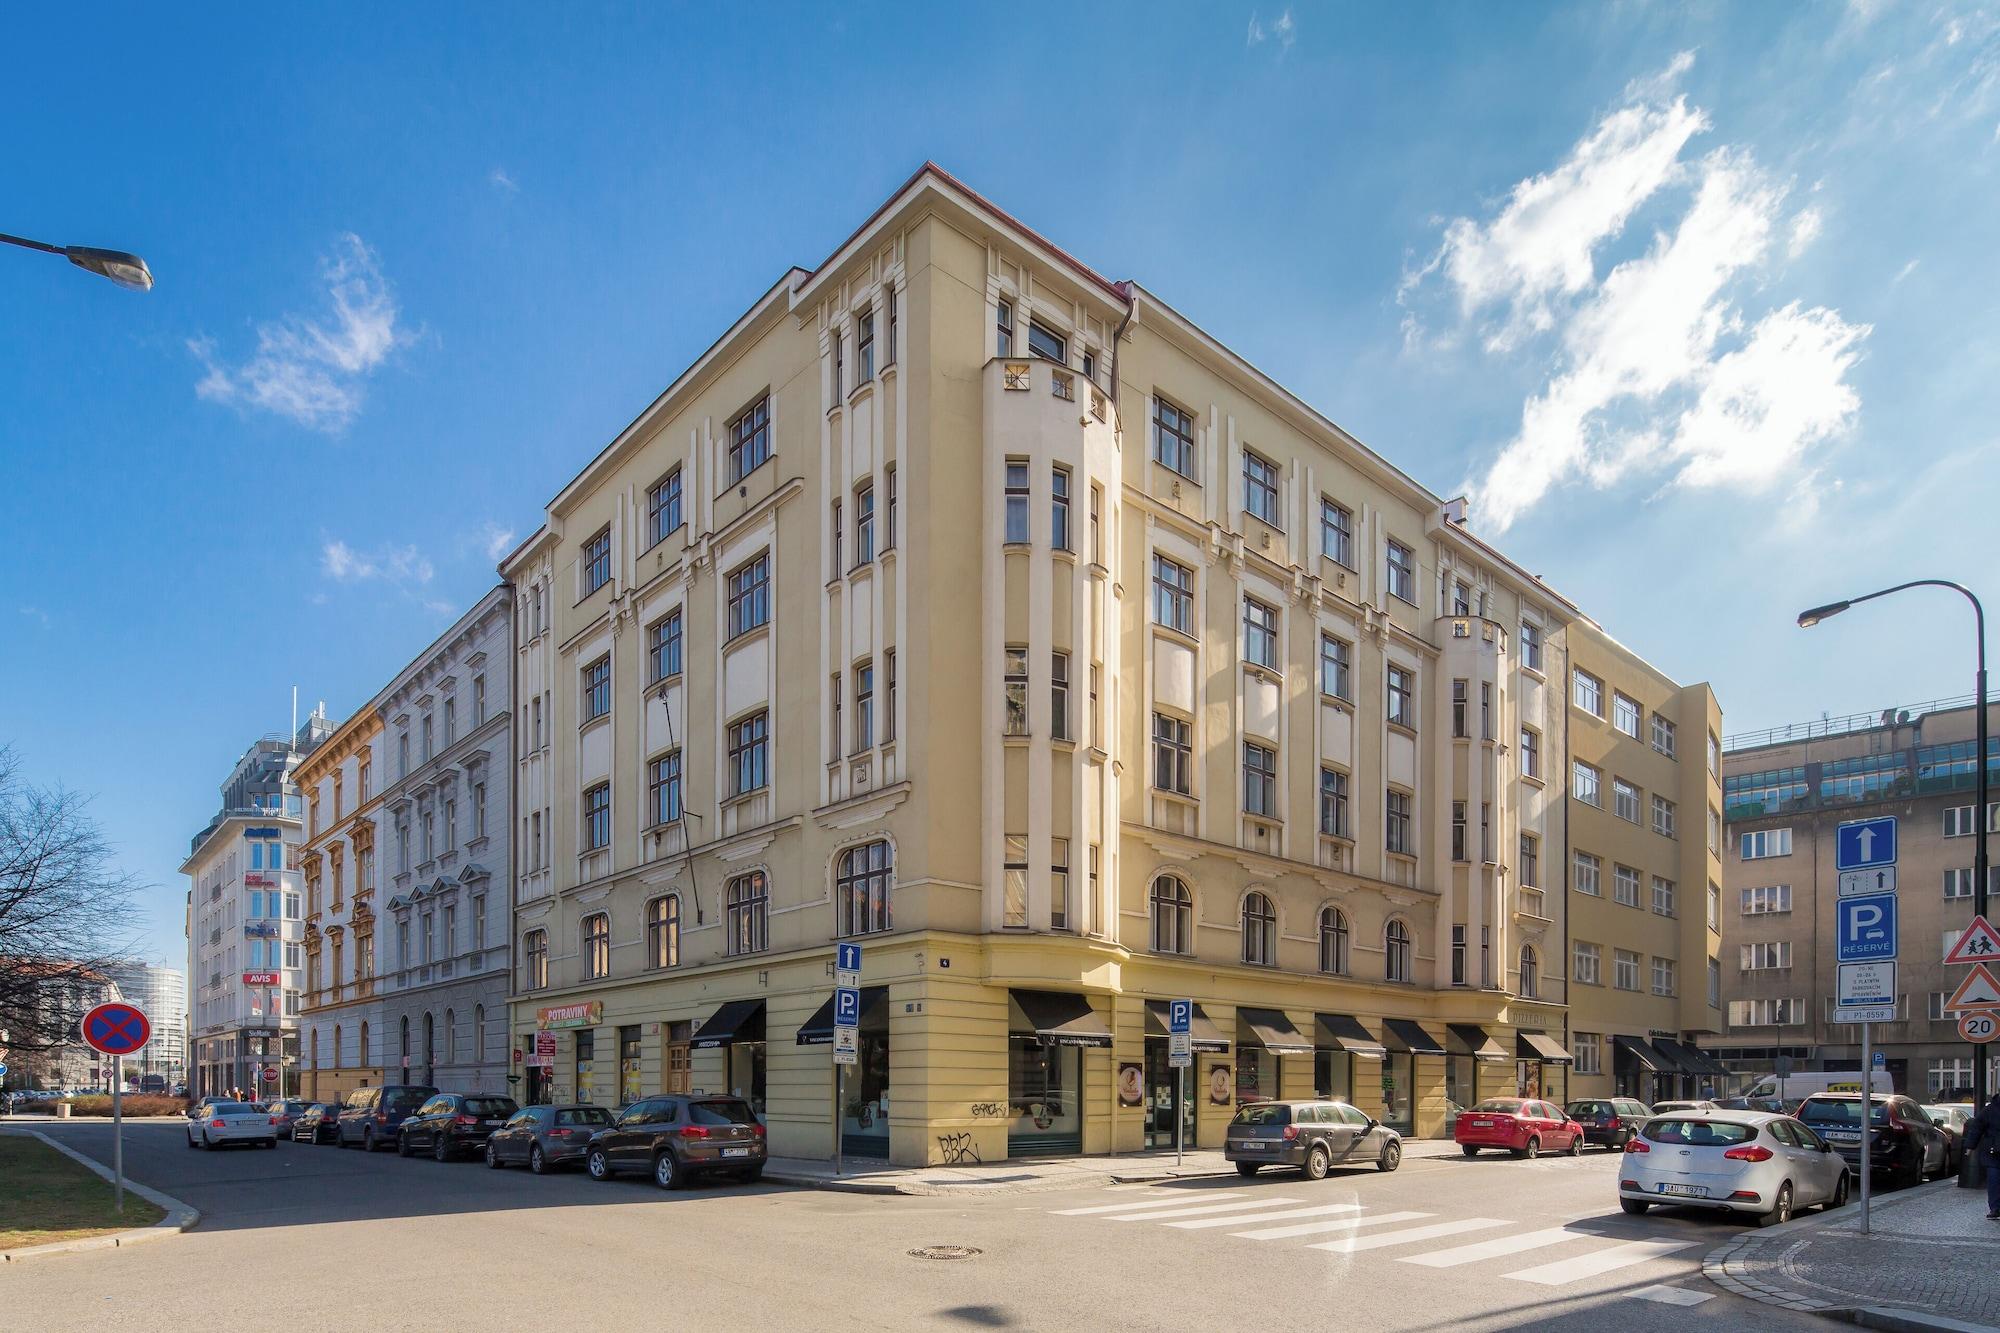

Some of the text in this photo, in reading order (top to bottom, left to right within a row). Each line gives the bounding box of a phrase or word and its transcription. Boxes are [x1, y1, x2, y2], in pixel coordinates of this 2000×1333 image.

[1850, 904, 1882, 941] P
[1843, 941, 1890, 953] RÉSERVÉ
[250, 975, 271, 983] AVIS
[841, 993, 855, 1015] P
[548, 1005, 588, 1021] POTRAVINY
[1174, 1004, 1187, 1024] P
[1968, 1020, 1990, 1033] 20
[1665, 1184, 1703, 1194] 3AU 1971
